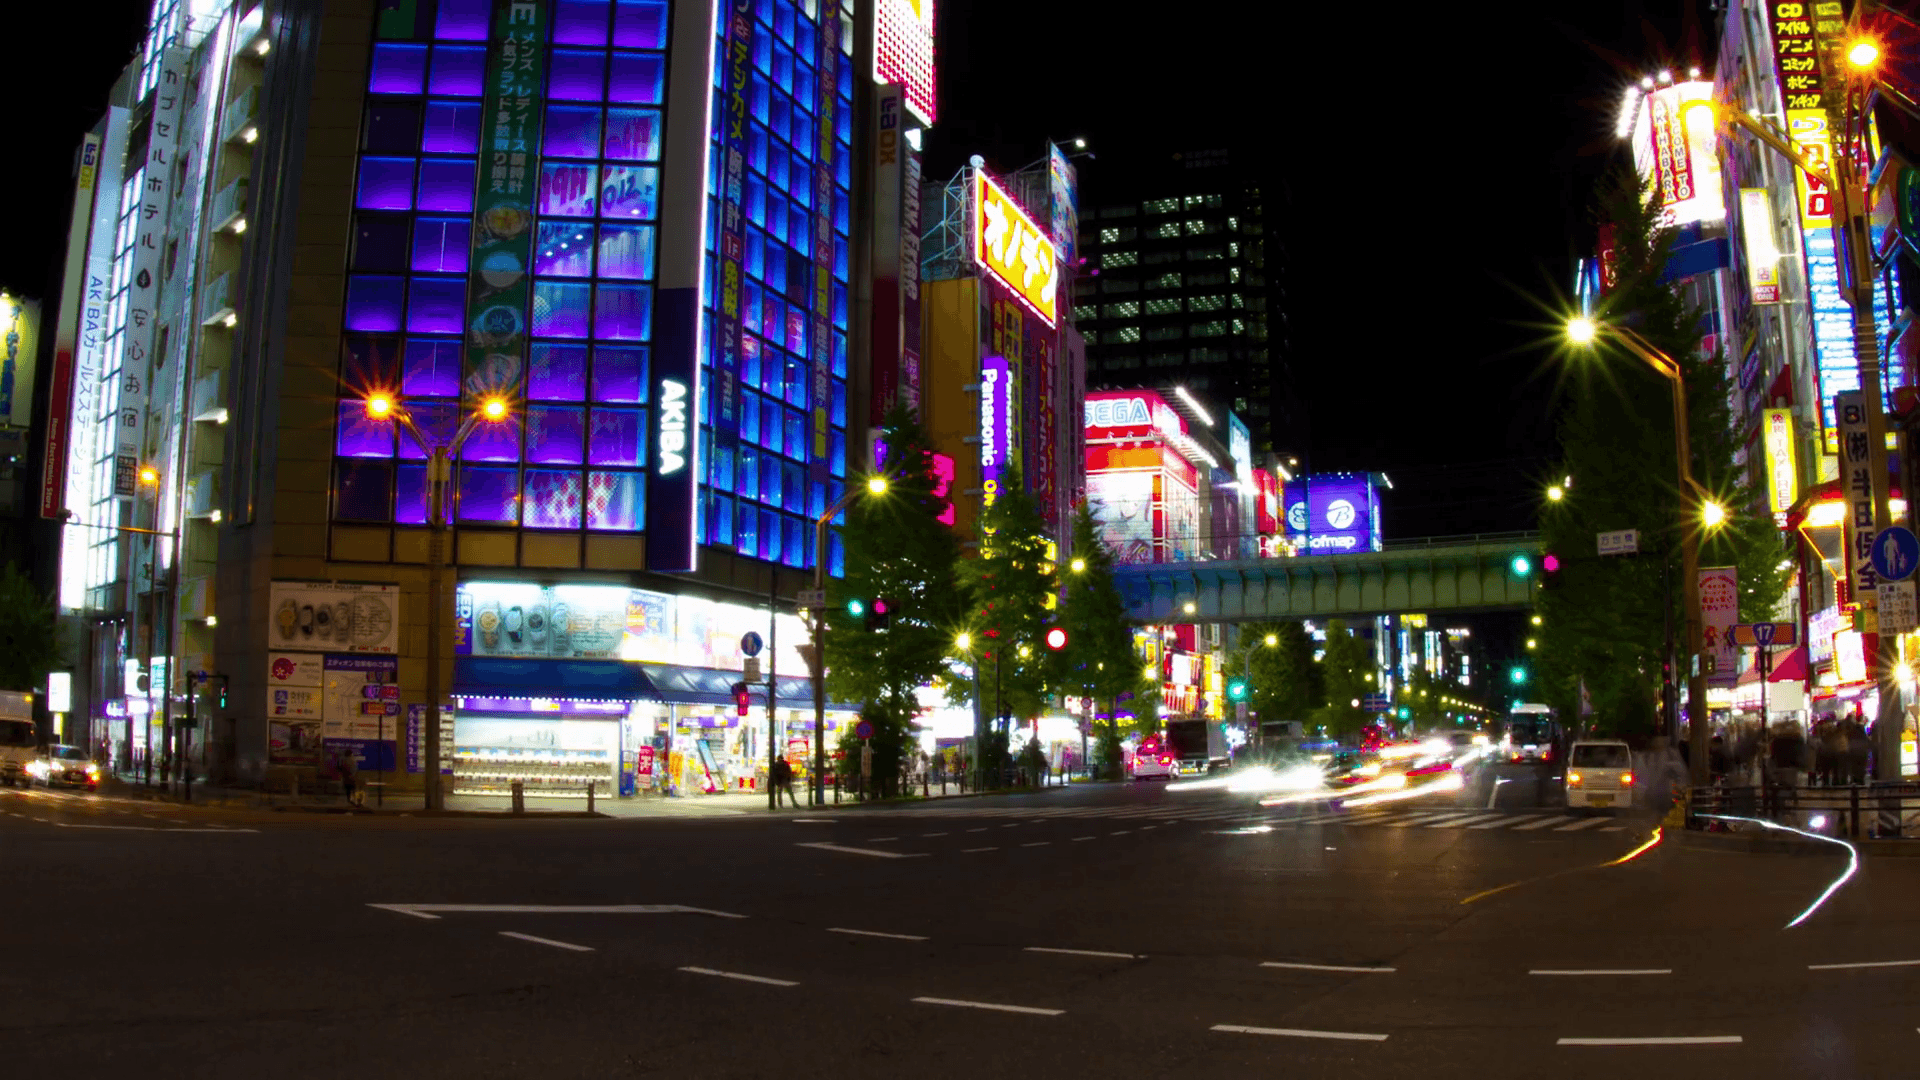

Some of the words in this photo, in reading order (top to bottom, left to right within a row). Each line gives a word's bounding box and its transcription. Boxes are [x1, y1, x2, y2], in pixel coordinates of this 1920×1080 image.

[1777, 3, 1803, 18] CD
[1776, 21, 1810, 35] アイドル
[1778, 39, 1814, 53] アニメ
[1782, 57, 1815, 71] コミック
[1787, 75, 1817, 90] ホビー
[1787, 94, 1821, 108] フィギュア
[1655, 102, 1676, 201] AKIHABARA
[1677, 174, 1690, 199] TO
[983, 199, 1058, 303] オノデン
[982, 368, 998, 466] Panasonic
[1085, 399, 1150, 426] SEGA
[659, 379, 687, 475] AKIBA
[1757, 626, 1771, 641] 17
